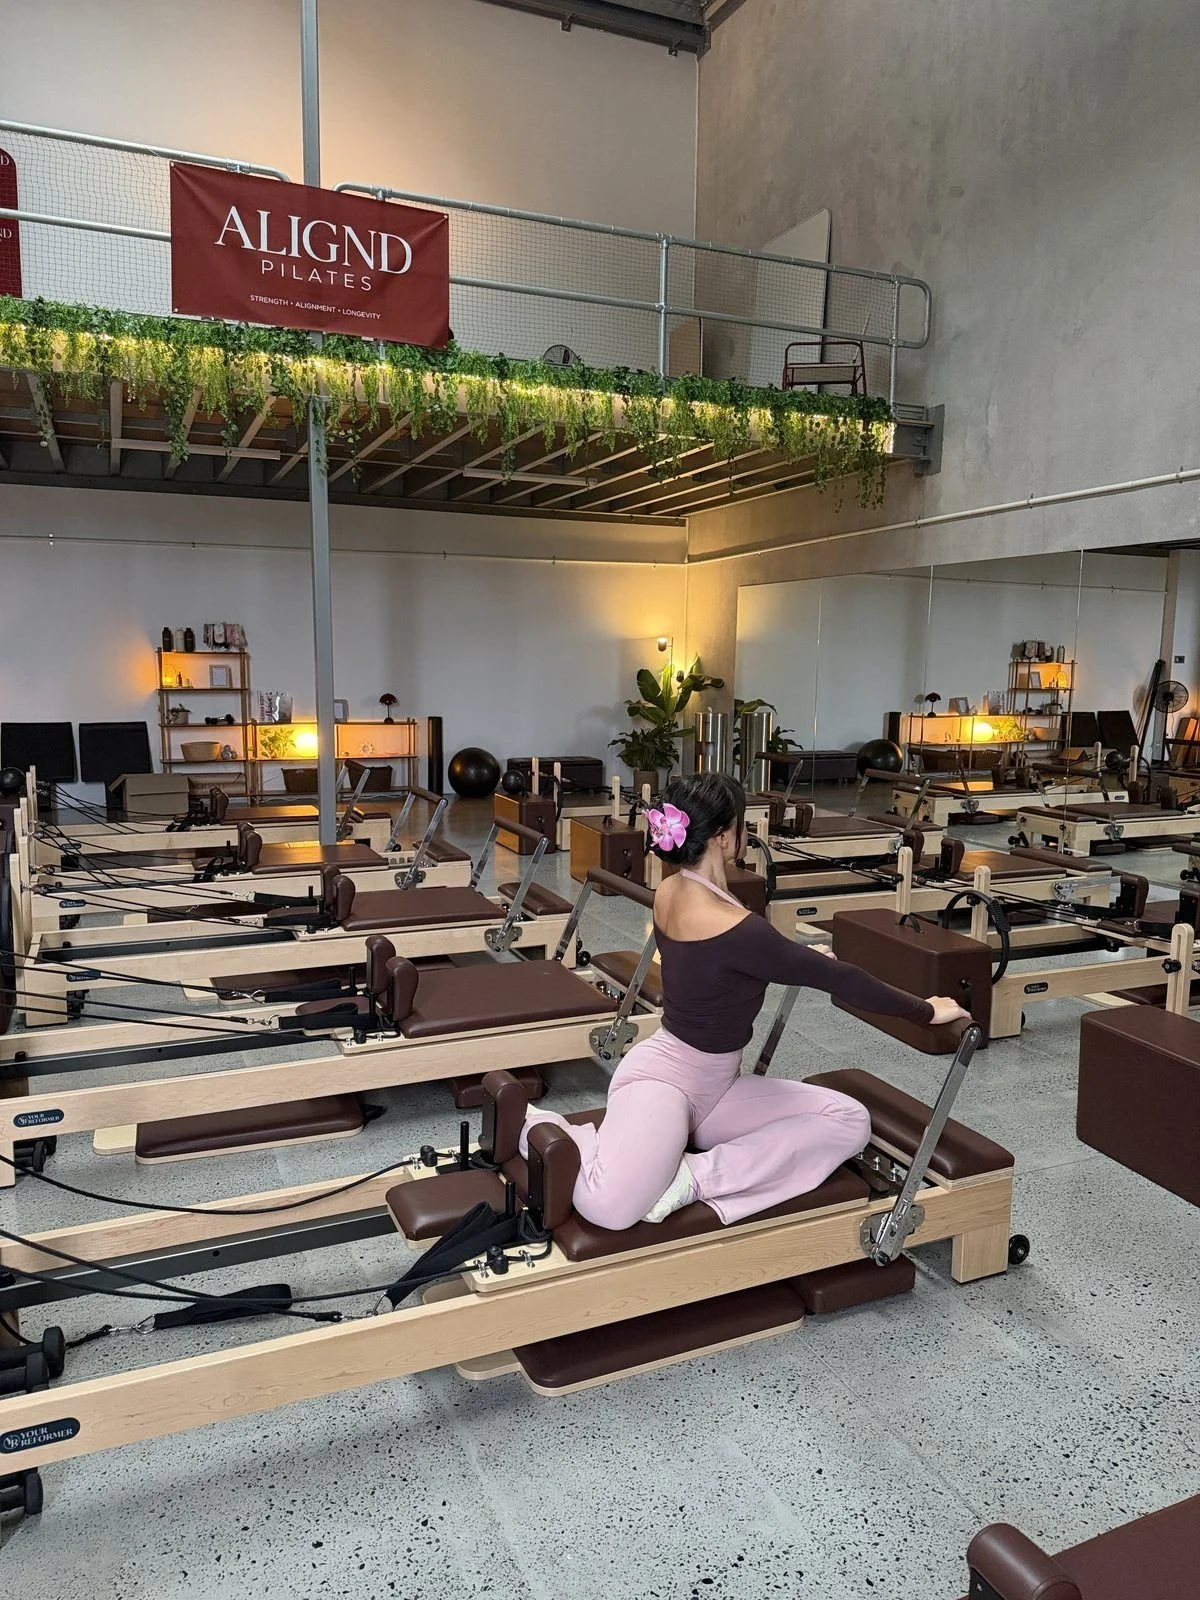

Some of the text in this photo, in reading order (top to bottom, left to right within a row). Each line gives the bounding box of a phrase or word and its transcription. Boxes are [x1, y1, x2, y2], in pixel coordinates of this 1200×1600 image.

[214, 205, 412, 274] ALIGND
[261, 259, 372, 291] PILATES
[250, 294, 381, 320] STRENGTH ALIGNMENT LONGEVITY
[20, 1427, 47, 1439] YOUR
[20, 1428, 73, 1447] REFORMER
